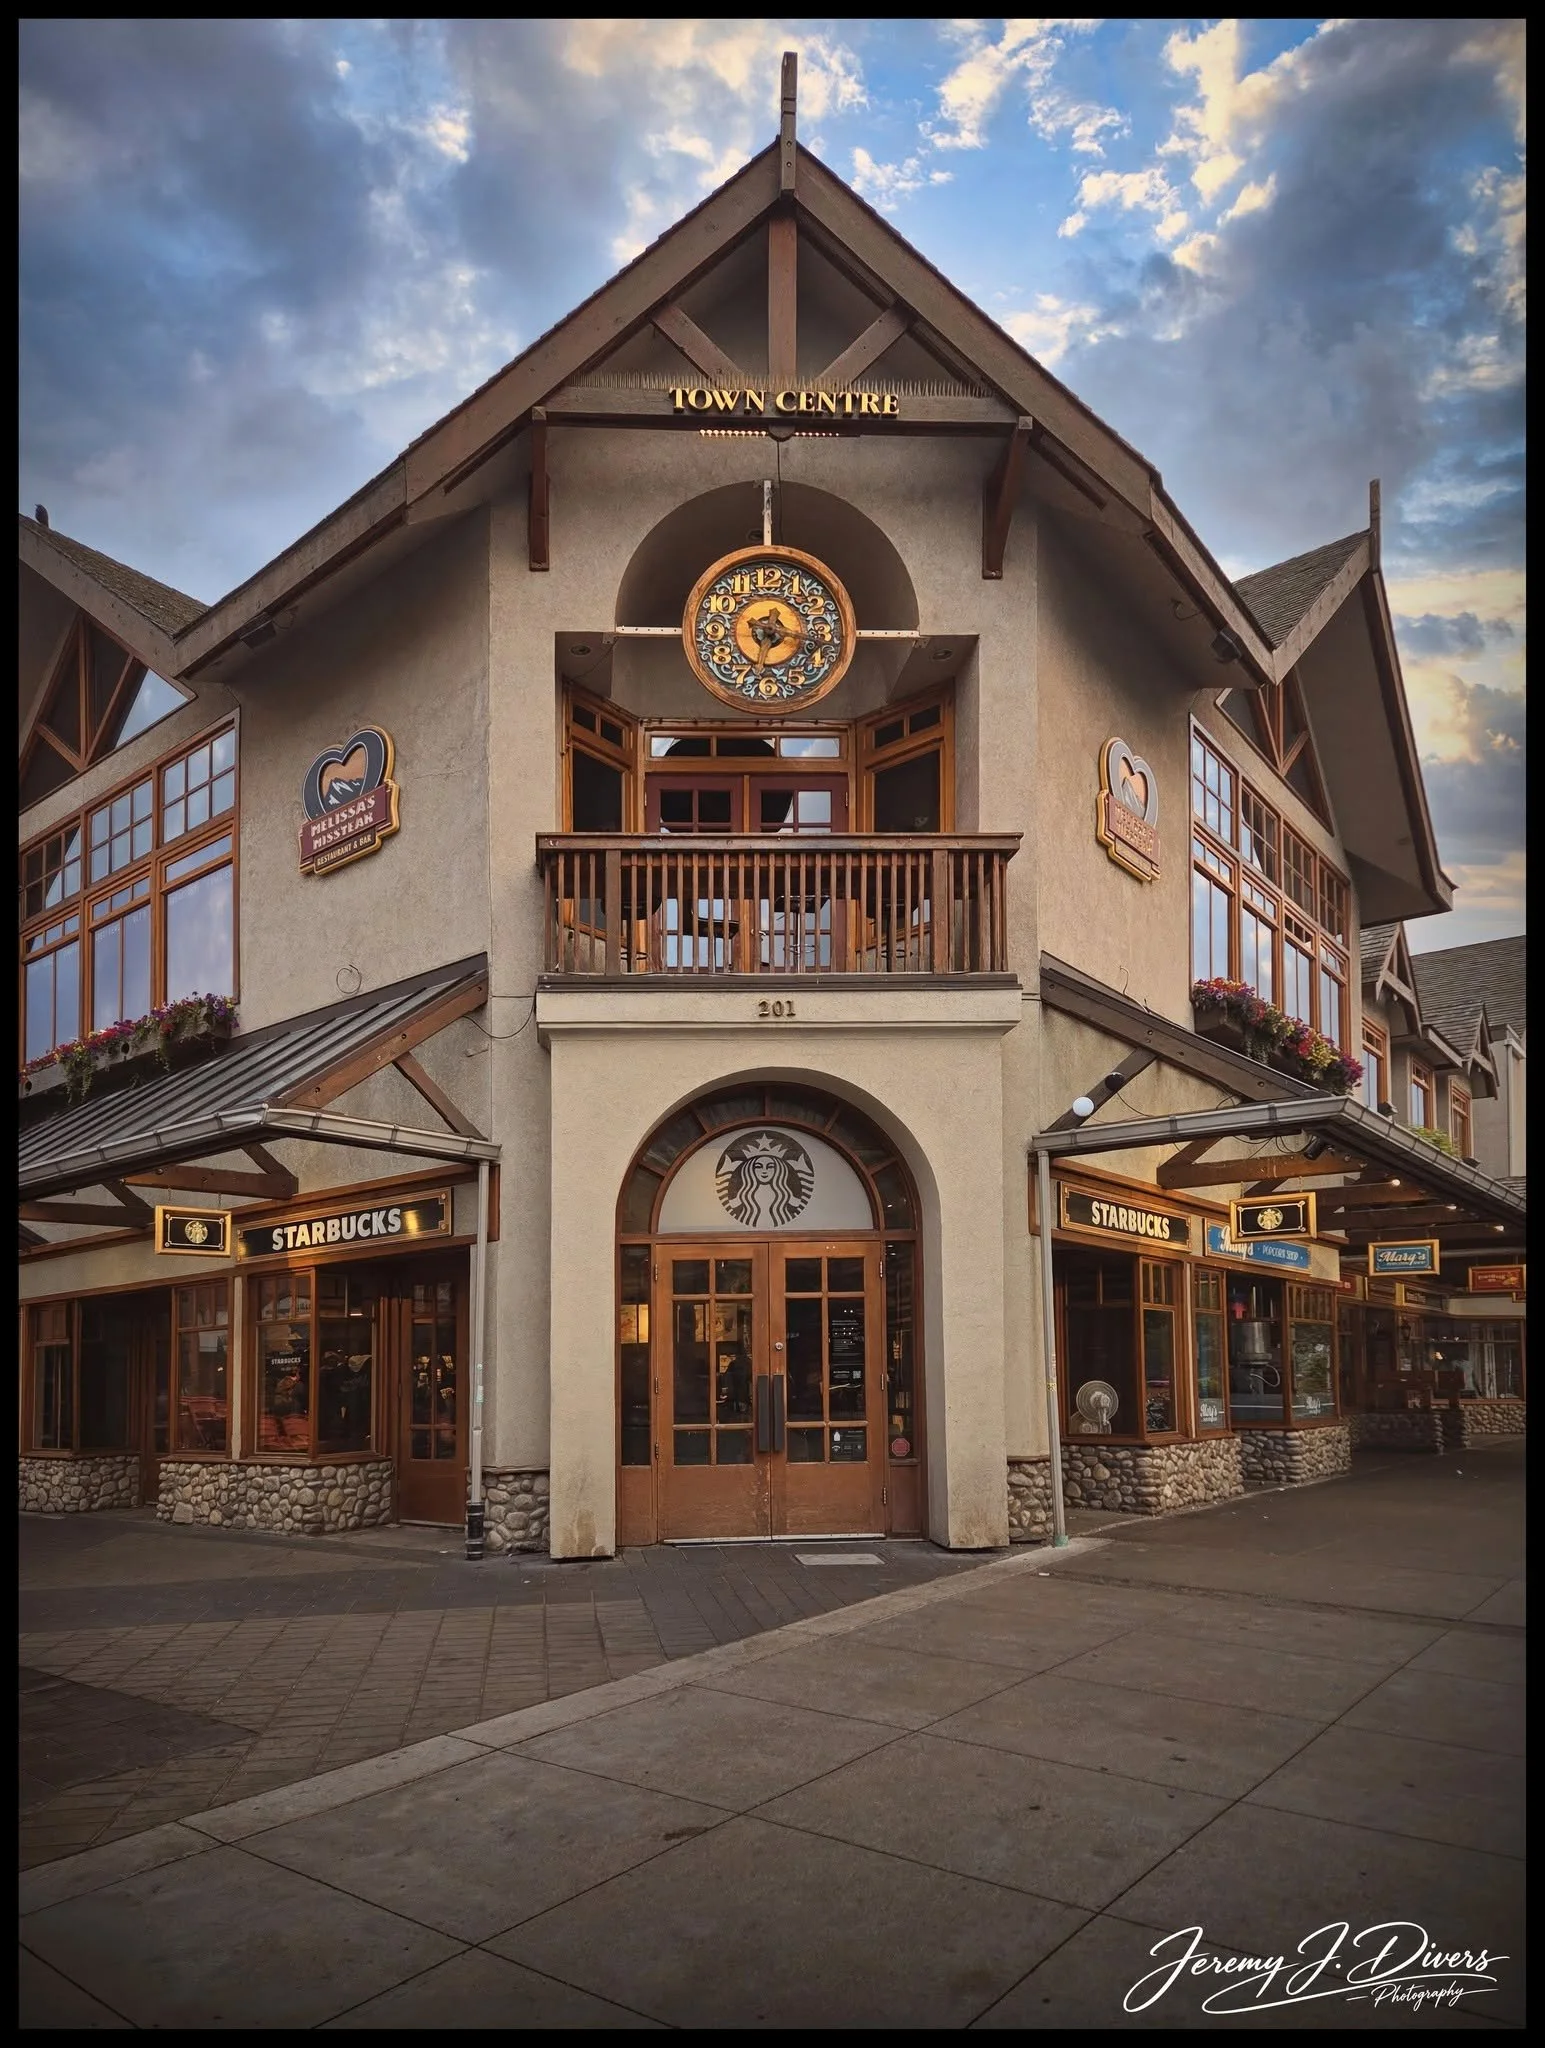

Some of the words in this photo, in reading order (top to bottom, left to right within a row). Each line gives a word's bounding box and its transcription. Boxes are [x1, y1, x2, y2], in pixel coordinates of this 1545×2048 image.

[669, 387, 766, 414] TOWN
[776, 390, 900, 416] CENTRE
[732, 574, 751, 594] 11
[756, 568, 783, 588] 12
[791, 575, 801, 595] 1
[709, 594, 736, 614] 10
[807, 596, 825, 615] 2
[705, 622, 725, 641] 9
[814, 623, 832, 642] 3
[713, 645, 731, 664] 8
[810, 648, 826, 667] 4
[733, 664, 751, 685] 7
[788, 667, 805, 685] 5
[759, 677, 778, 696] 6
[311, 795, 376, 837] MELISSA'S
[313, 812, 374, 850] MISSTEAK
[316, 842, 352, 866] RESTAURANT
[353, 840, 358, 849] &
[359, 833, 372, 846] BAR
[759, 1000, 796, 1017] 201
[272, 1208, 401, 1251] STARBUCKS
[1092, 1200, 1170, 1240] STARBUCKS
[1378, 1251, 1426, 1266] Mary's
[271, 1356, 301, 1365] STARBUCKS
